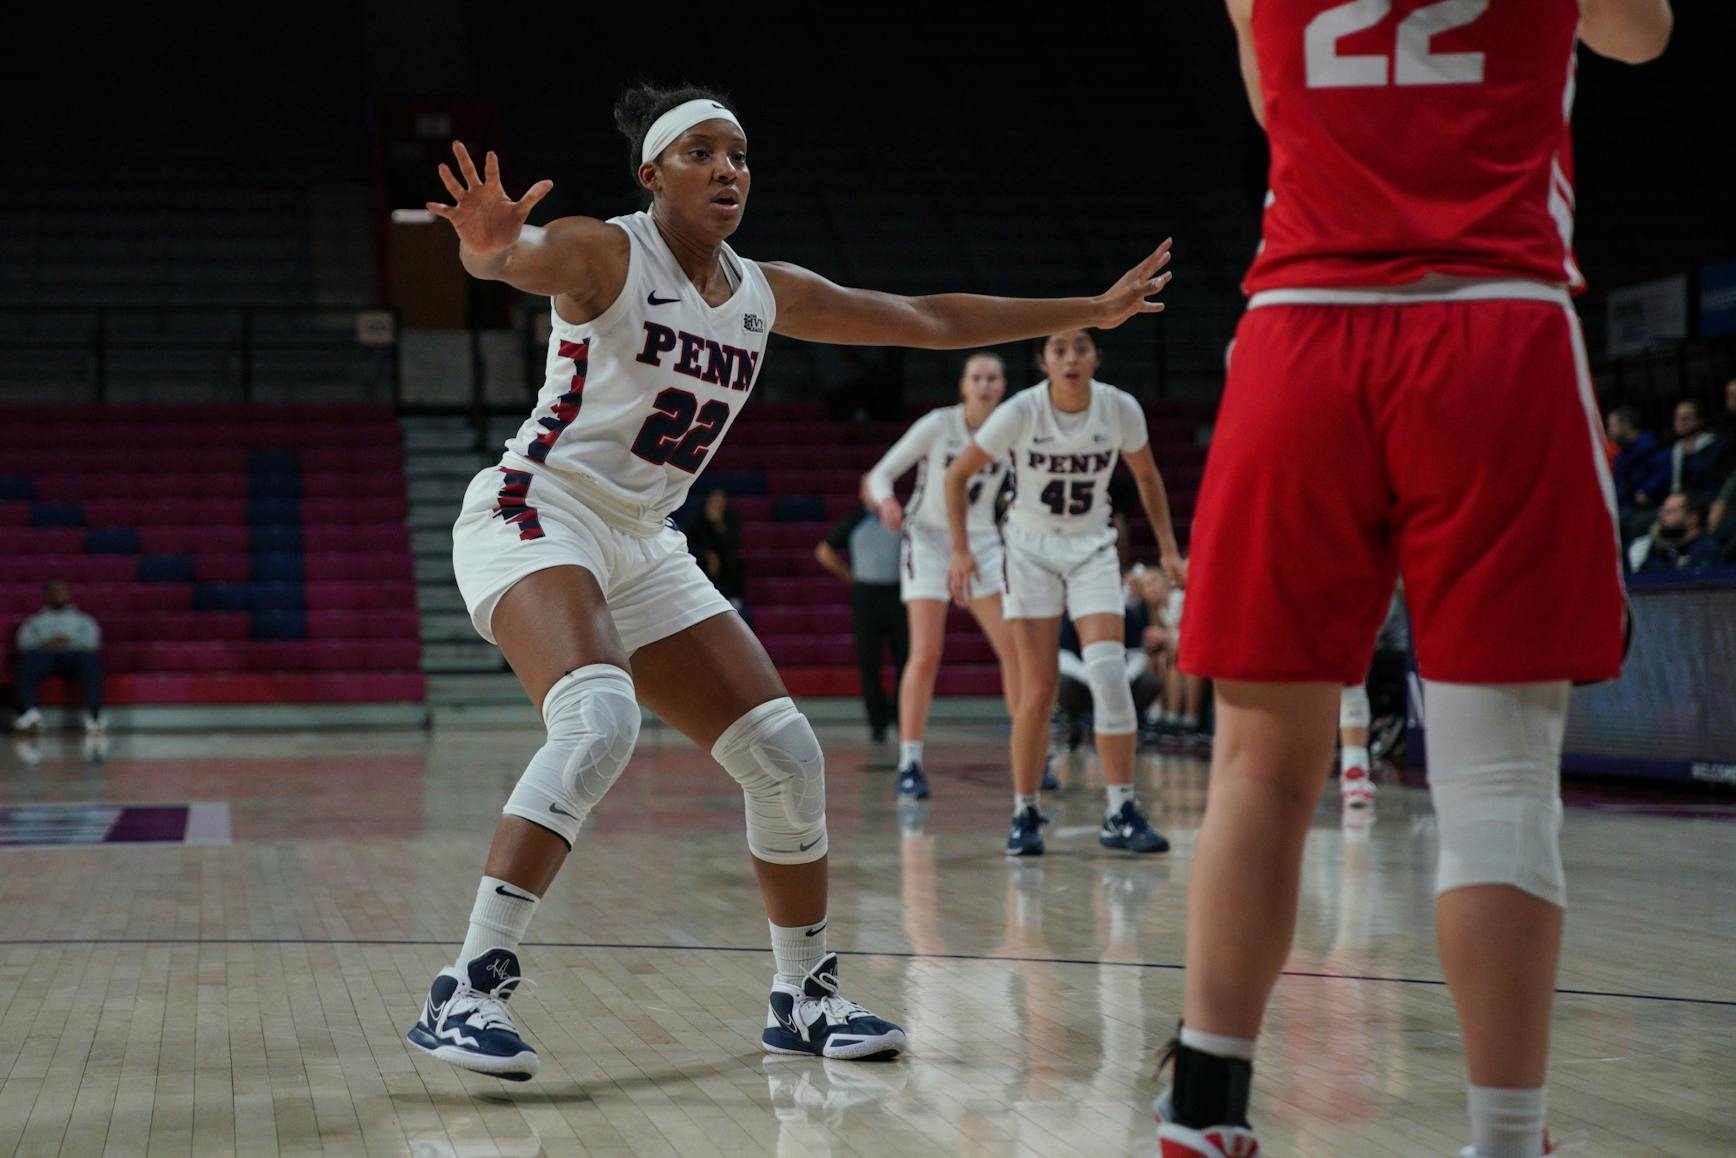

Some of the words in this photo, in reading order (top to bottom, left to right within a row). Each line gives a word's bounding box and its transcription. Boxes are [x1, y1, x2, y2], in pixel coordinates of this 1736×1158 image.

[1304, 0, 1490, 89] 22
[636, 321, 759, 393] PENN
[630, 387, 730, 474] 22
[1028, 449, 1113, 474] PENN
[1040, 479, 1096, 515] 45
